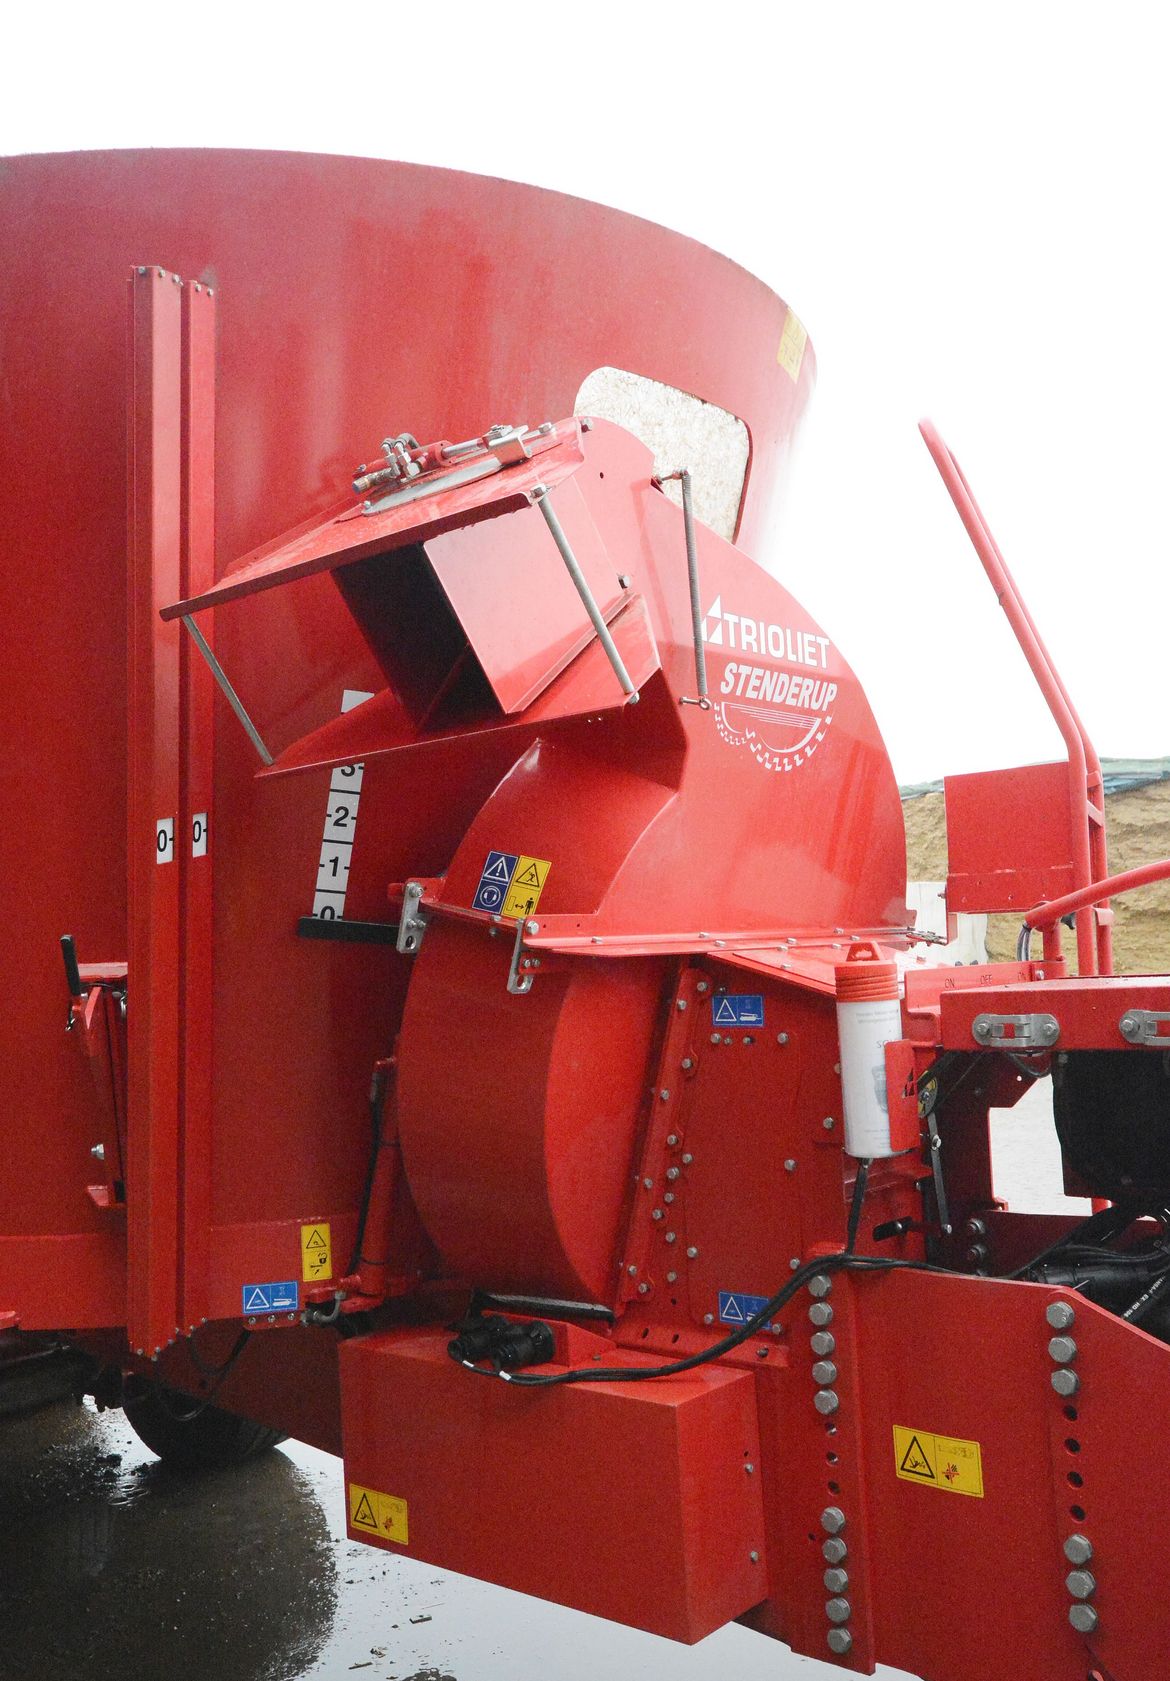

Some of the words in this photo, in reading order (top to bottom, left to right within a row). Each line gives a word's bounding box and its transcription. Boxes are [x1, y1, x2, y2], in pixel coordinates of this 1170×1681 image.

[724, 612, 829, 668] TRIOLIET
[720, 662, 838, 711] STENDERUP
[332, 806, 349, 827] 2
[157, 829, 167, 852] 0
[193, 820, 201, 843] 0
[329, 856, 340, 877] 1
[944, 978, 955, 988] ON
